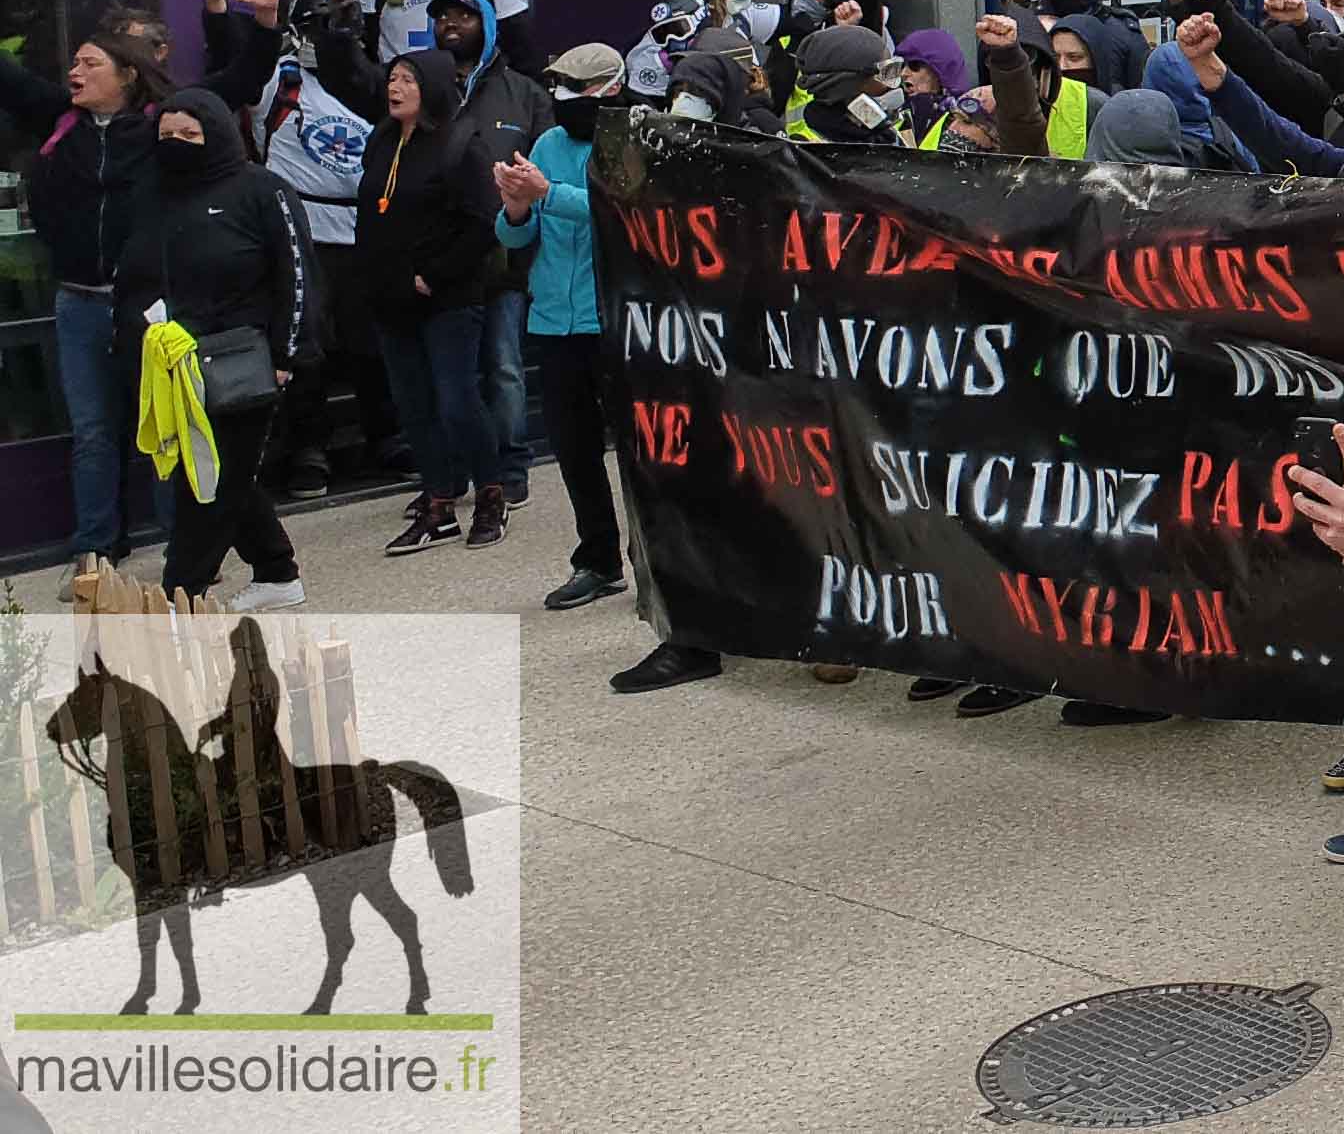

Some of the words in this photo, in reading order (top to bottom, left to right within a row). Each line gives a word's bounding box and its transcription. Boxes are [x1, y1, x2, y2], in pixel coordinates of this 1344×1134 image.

[1102, 242, 1311, 323] ARMES
[1061, 330, 1177, 404] QUE
[633, 401, 693, 466] NE
[871, 440, 1161, 542] SUICIDEZ
[1177, 449, 1299, 535] PAS
[814, 553, 953, 640] POUR
